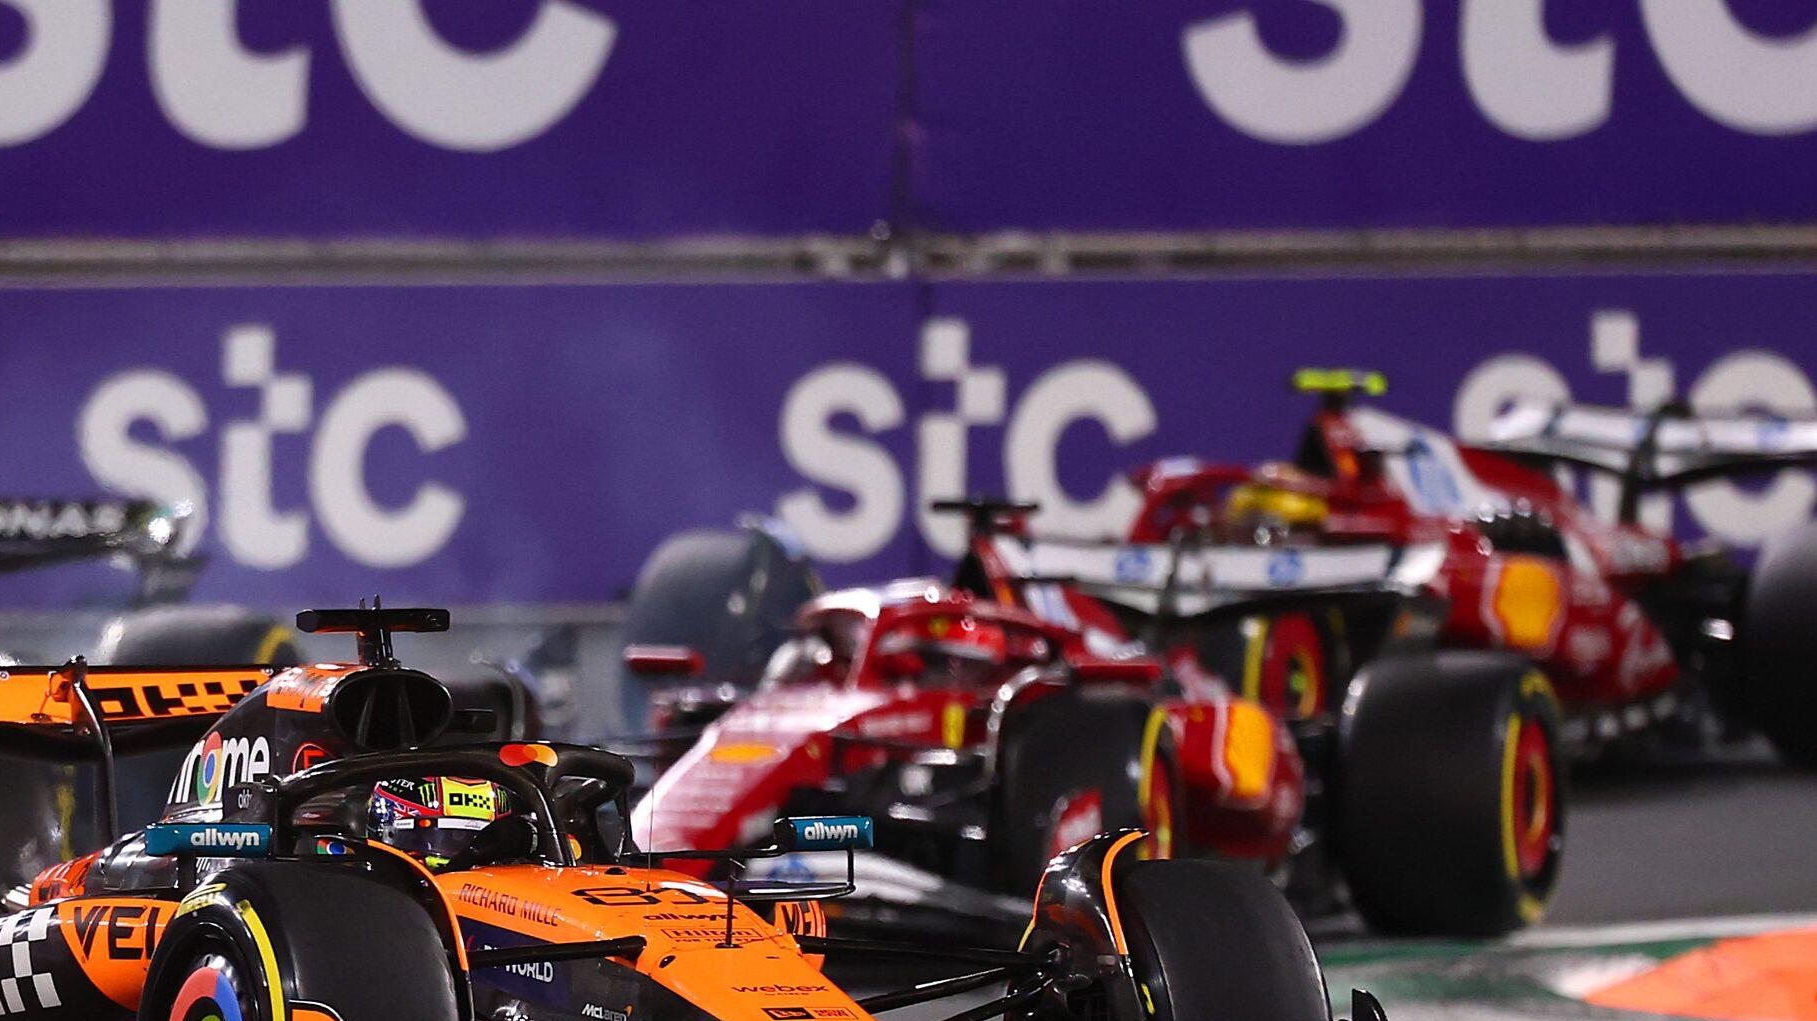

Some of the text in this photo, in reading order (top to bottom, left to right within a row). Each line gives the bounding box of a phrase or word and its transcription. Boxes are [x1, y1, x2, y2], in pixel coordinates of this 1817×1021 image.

[75, 325, 467, 571] stc
[776, 318, 1158, 562] stc
[448, 792, 491, 810] OKX
[190, 828, 260, 850] allwyn
[804, 821, 858, 843] allwyn
[459, 883, 562, 927] RICHARD MILLE
[643, 913, 739, 921] allwyn
[731, 984, 830, 993] webex
